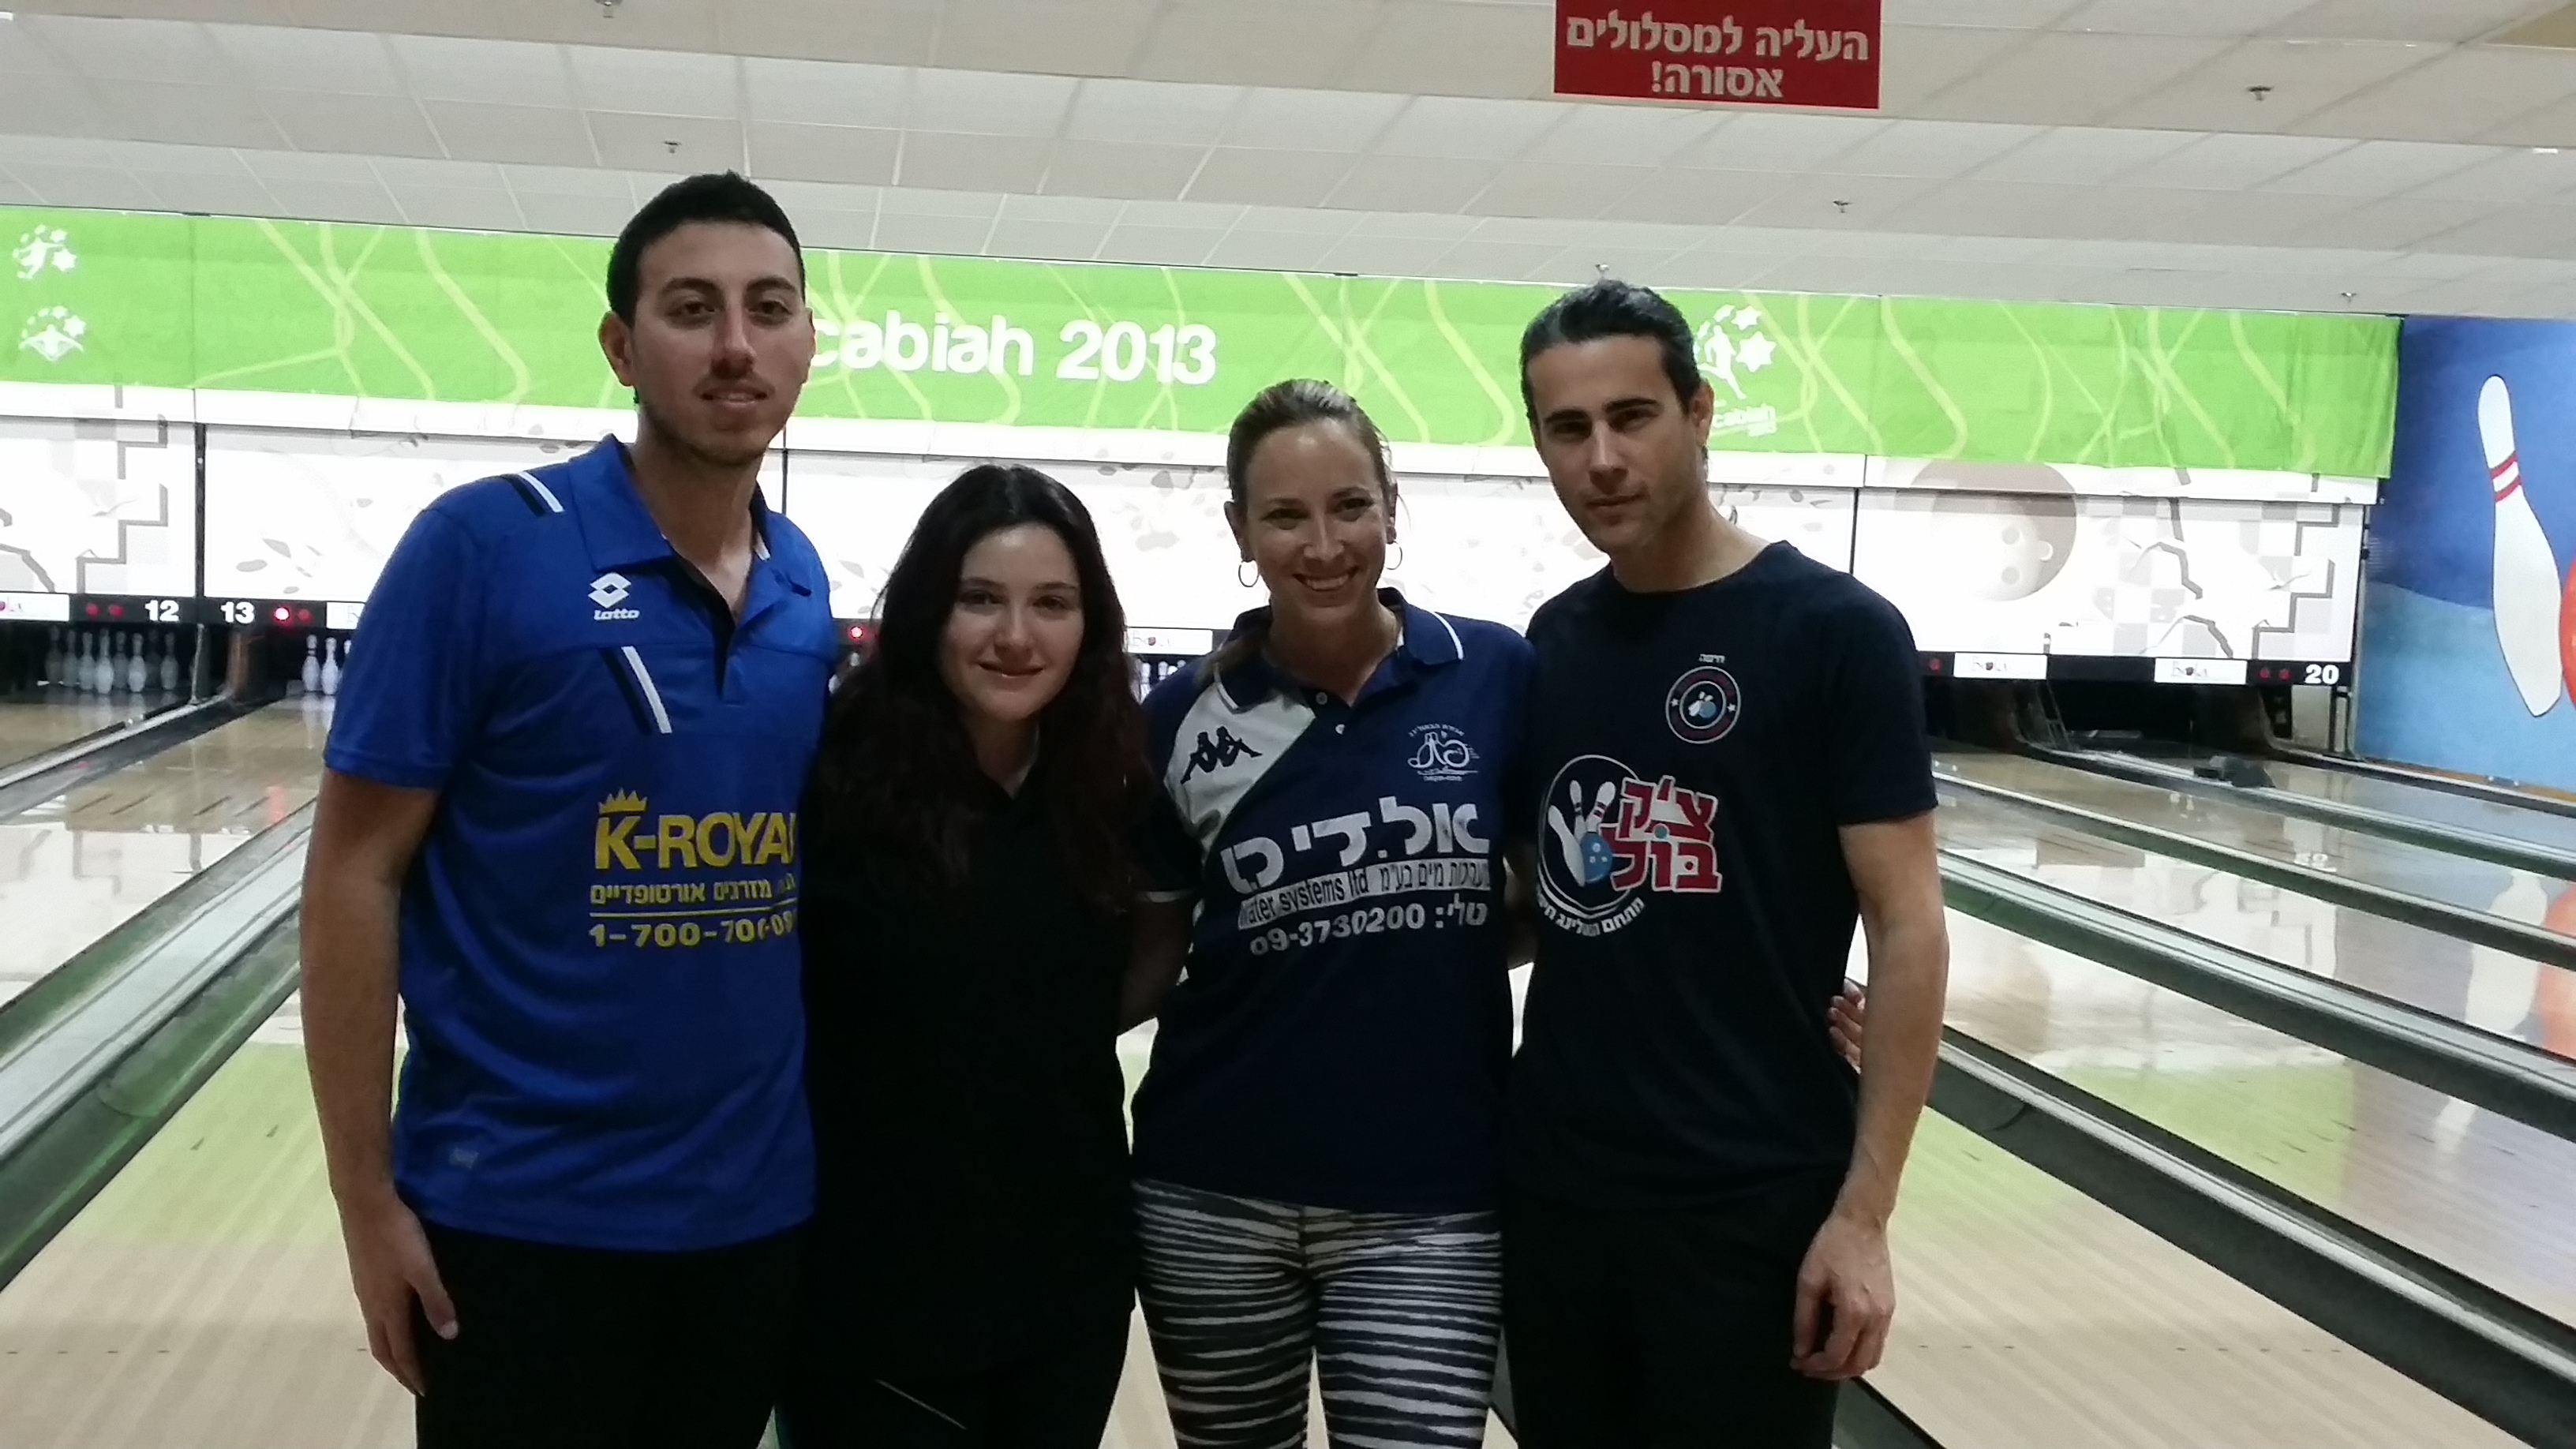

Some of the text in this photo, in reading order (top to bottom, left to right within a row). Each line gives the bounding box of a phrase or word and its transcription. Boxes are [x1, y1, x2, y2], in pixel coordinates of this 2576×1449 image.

[1567, 9, 1869, 62] העליה למסלולים
[1650, 60, 1784, 98] אסורה!
[1055, 319, 1216, 384] 2013
[144, 599, 180, 622] 12
[220, 601, 256, 624] 13
[2304, 664, 2340, 685] 20
[1240, 868, 1369, 927] ater systems ltd
[1249, 902, 1426, 957] 09-3730200
